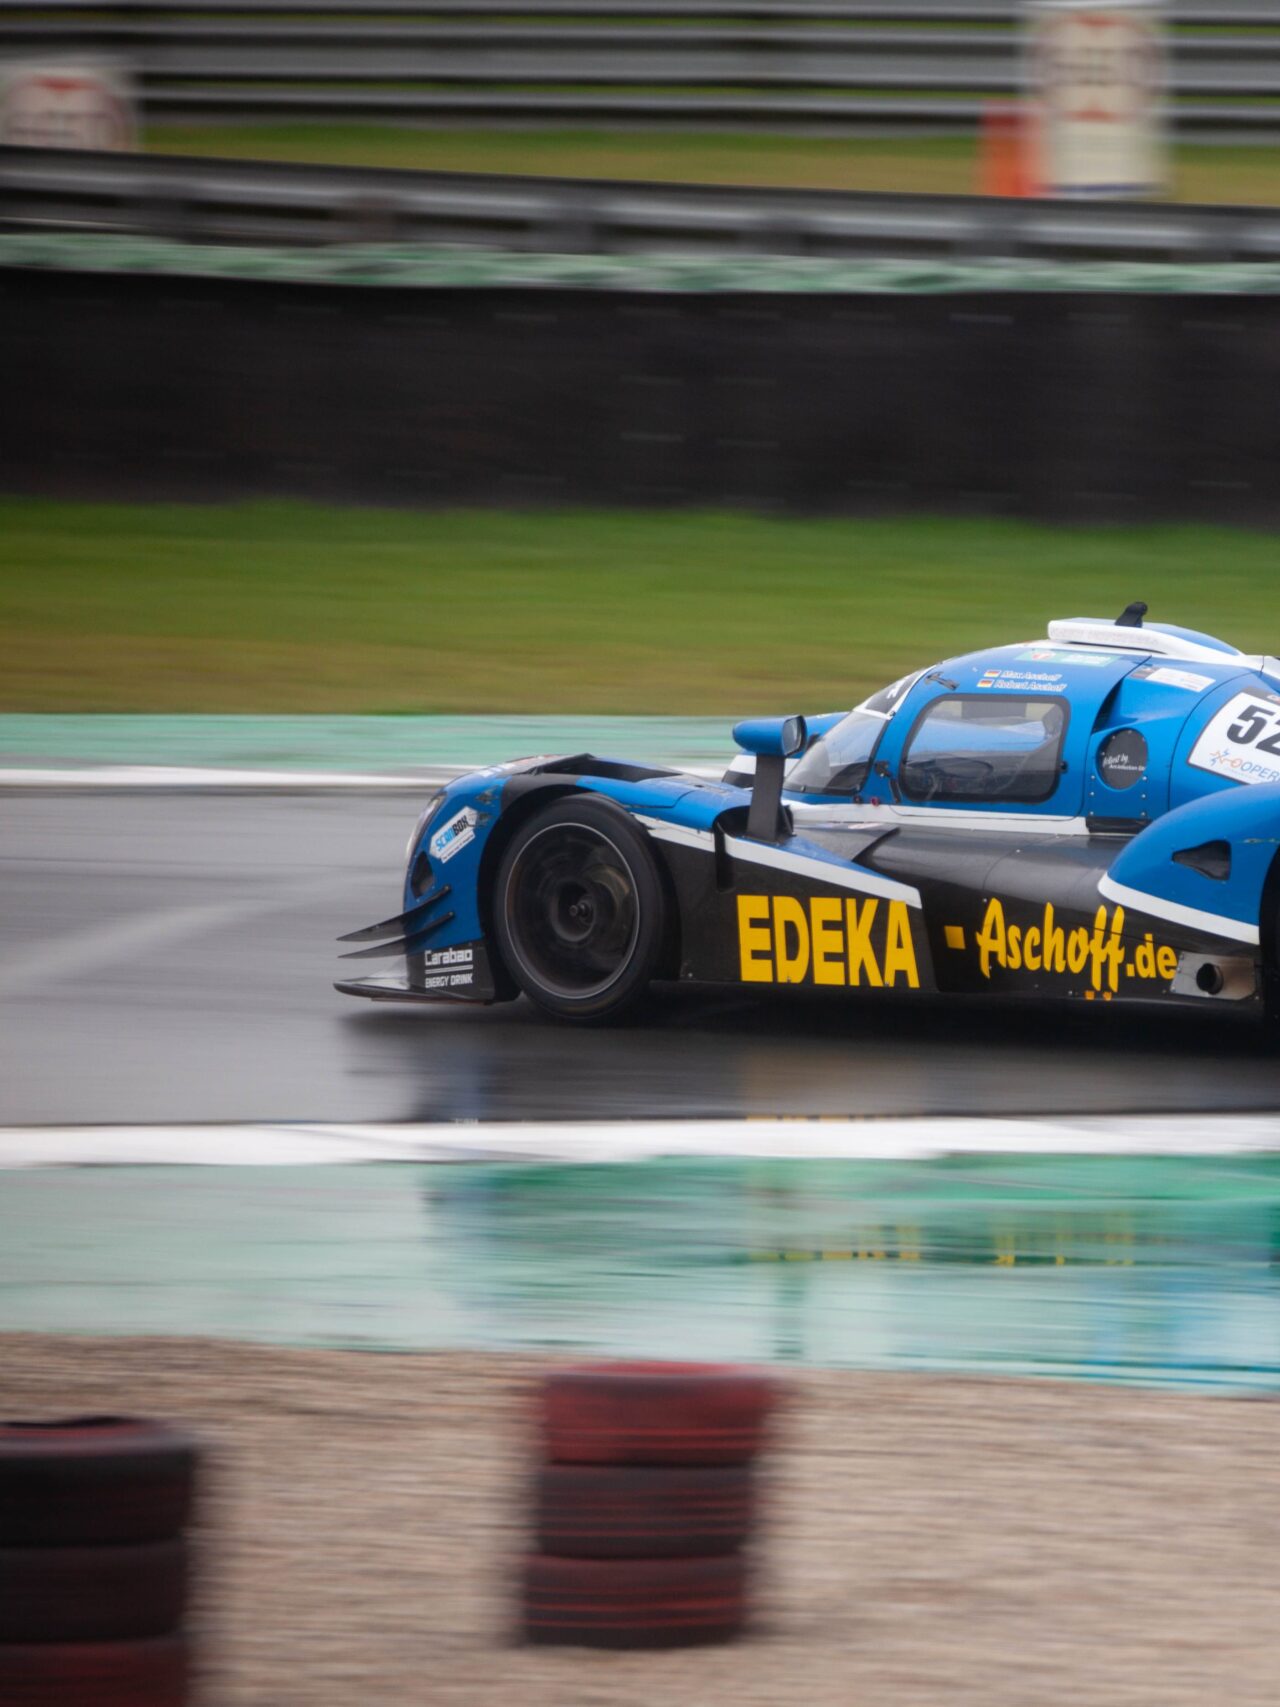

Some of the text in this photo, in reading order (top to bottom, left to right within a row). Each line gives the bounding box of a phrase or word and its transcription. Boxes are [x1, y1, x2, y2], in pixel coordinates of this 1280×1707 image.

[737, 895, 920, 988] EDEKA
[976, 897, 1179, 998] Aschoff.de
[425, 948, 473, 965] Carabao
[425, 973, 473, 988] ENERGY DRINK
